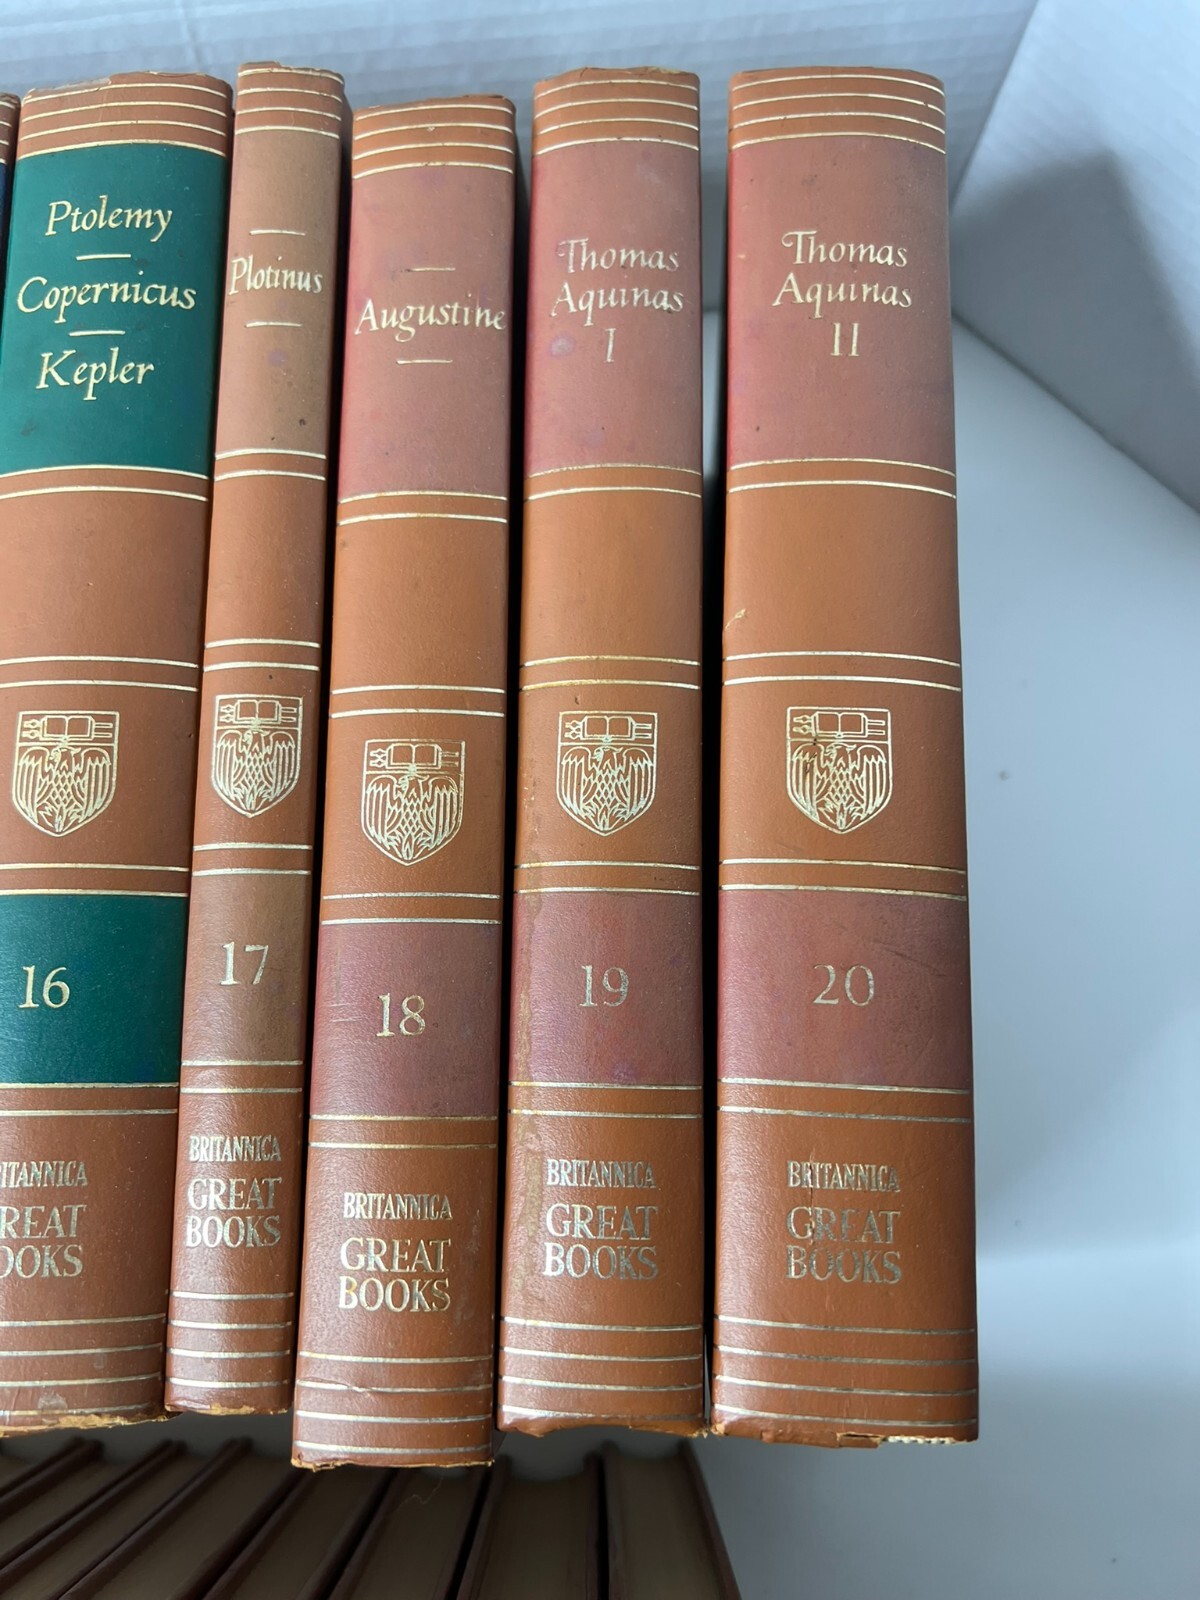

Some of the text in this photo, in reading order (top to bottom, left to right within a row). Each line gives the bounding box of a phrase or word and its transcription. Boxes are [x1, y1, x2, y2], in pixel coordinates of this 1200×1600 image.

[45, 195, 173, 242] Ptolemy
[557, 238, 680, 273] Thomas
[781, 230, 908, 268] Thomas
[228, 256, 324, 296] Plotinus
[16, 270, 197, 323] Copernicus
[549, 282, 684, 327] Aquinas
[772, 272, 913, 319] Aquinas
[354, 292, 507, 342] Augustine
[604, 328, 616, 363] I
[829, 322, 860, 357] II
[36, 347, 155, 400] Kepler
[219, 941, 269, 986] 17
[18, 965, 71, 1009] 16
[579, 964, 629, 1007] 19
[812, 963, 876, 1007] 20
[375, 992, 427, 1037] 18
[189, 1134, 282, 1162] BRITANNICA
[0, 1160, 88, 1188] ITANNICA
[546, 1158, 657, 1190] BRITANNICA
[787, 1160, 901, 1192] BRITANNICA
[187, 1176, 282, 1211] GREAT
[343, 1192, 453, 1220] BRITANNICA
[0, 1204, 87, 1239] REAT
[186, 1214, 281, 1248] BOOKS
[546, 1203, 658, 1241] GREAT
[786, 1206, 901, 1244] GREAT
[0, 1245, 83, 1278] OOKS
[340, 1236, 451, 1273] GREAT
[543, 1243, 658, 1281] BOOKS
[786, 1244, 901, 1284] BOOKS
[338, 1277, 451, 1312] BOOKS
